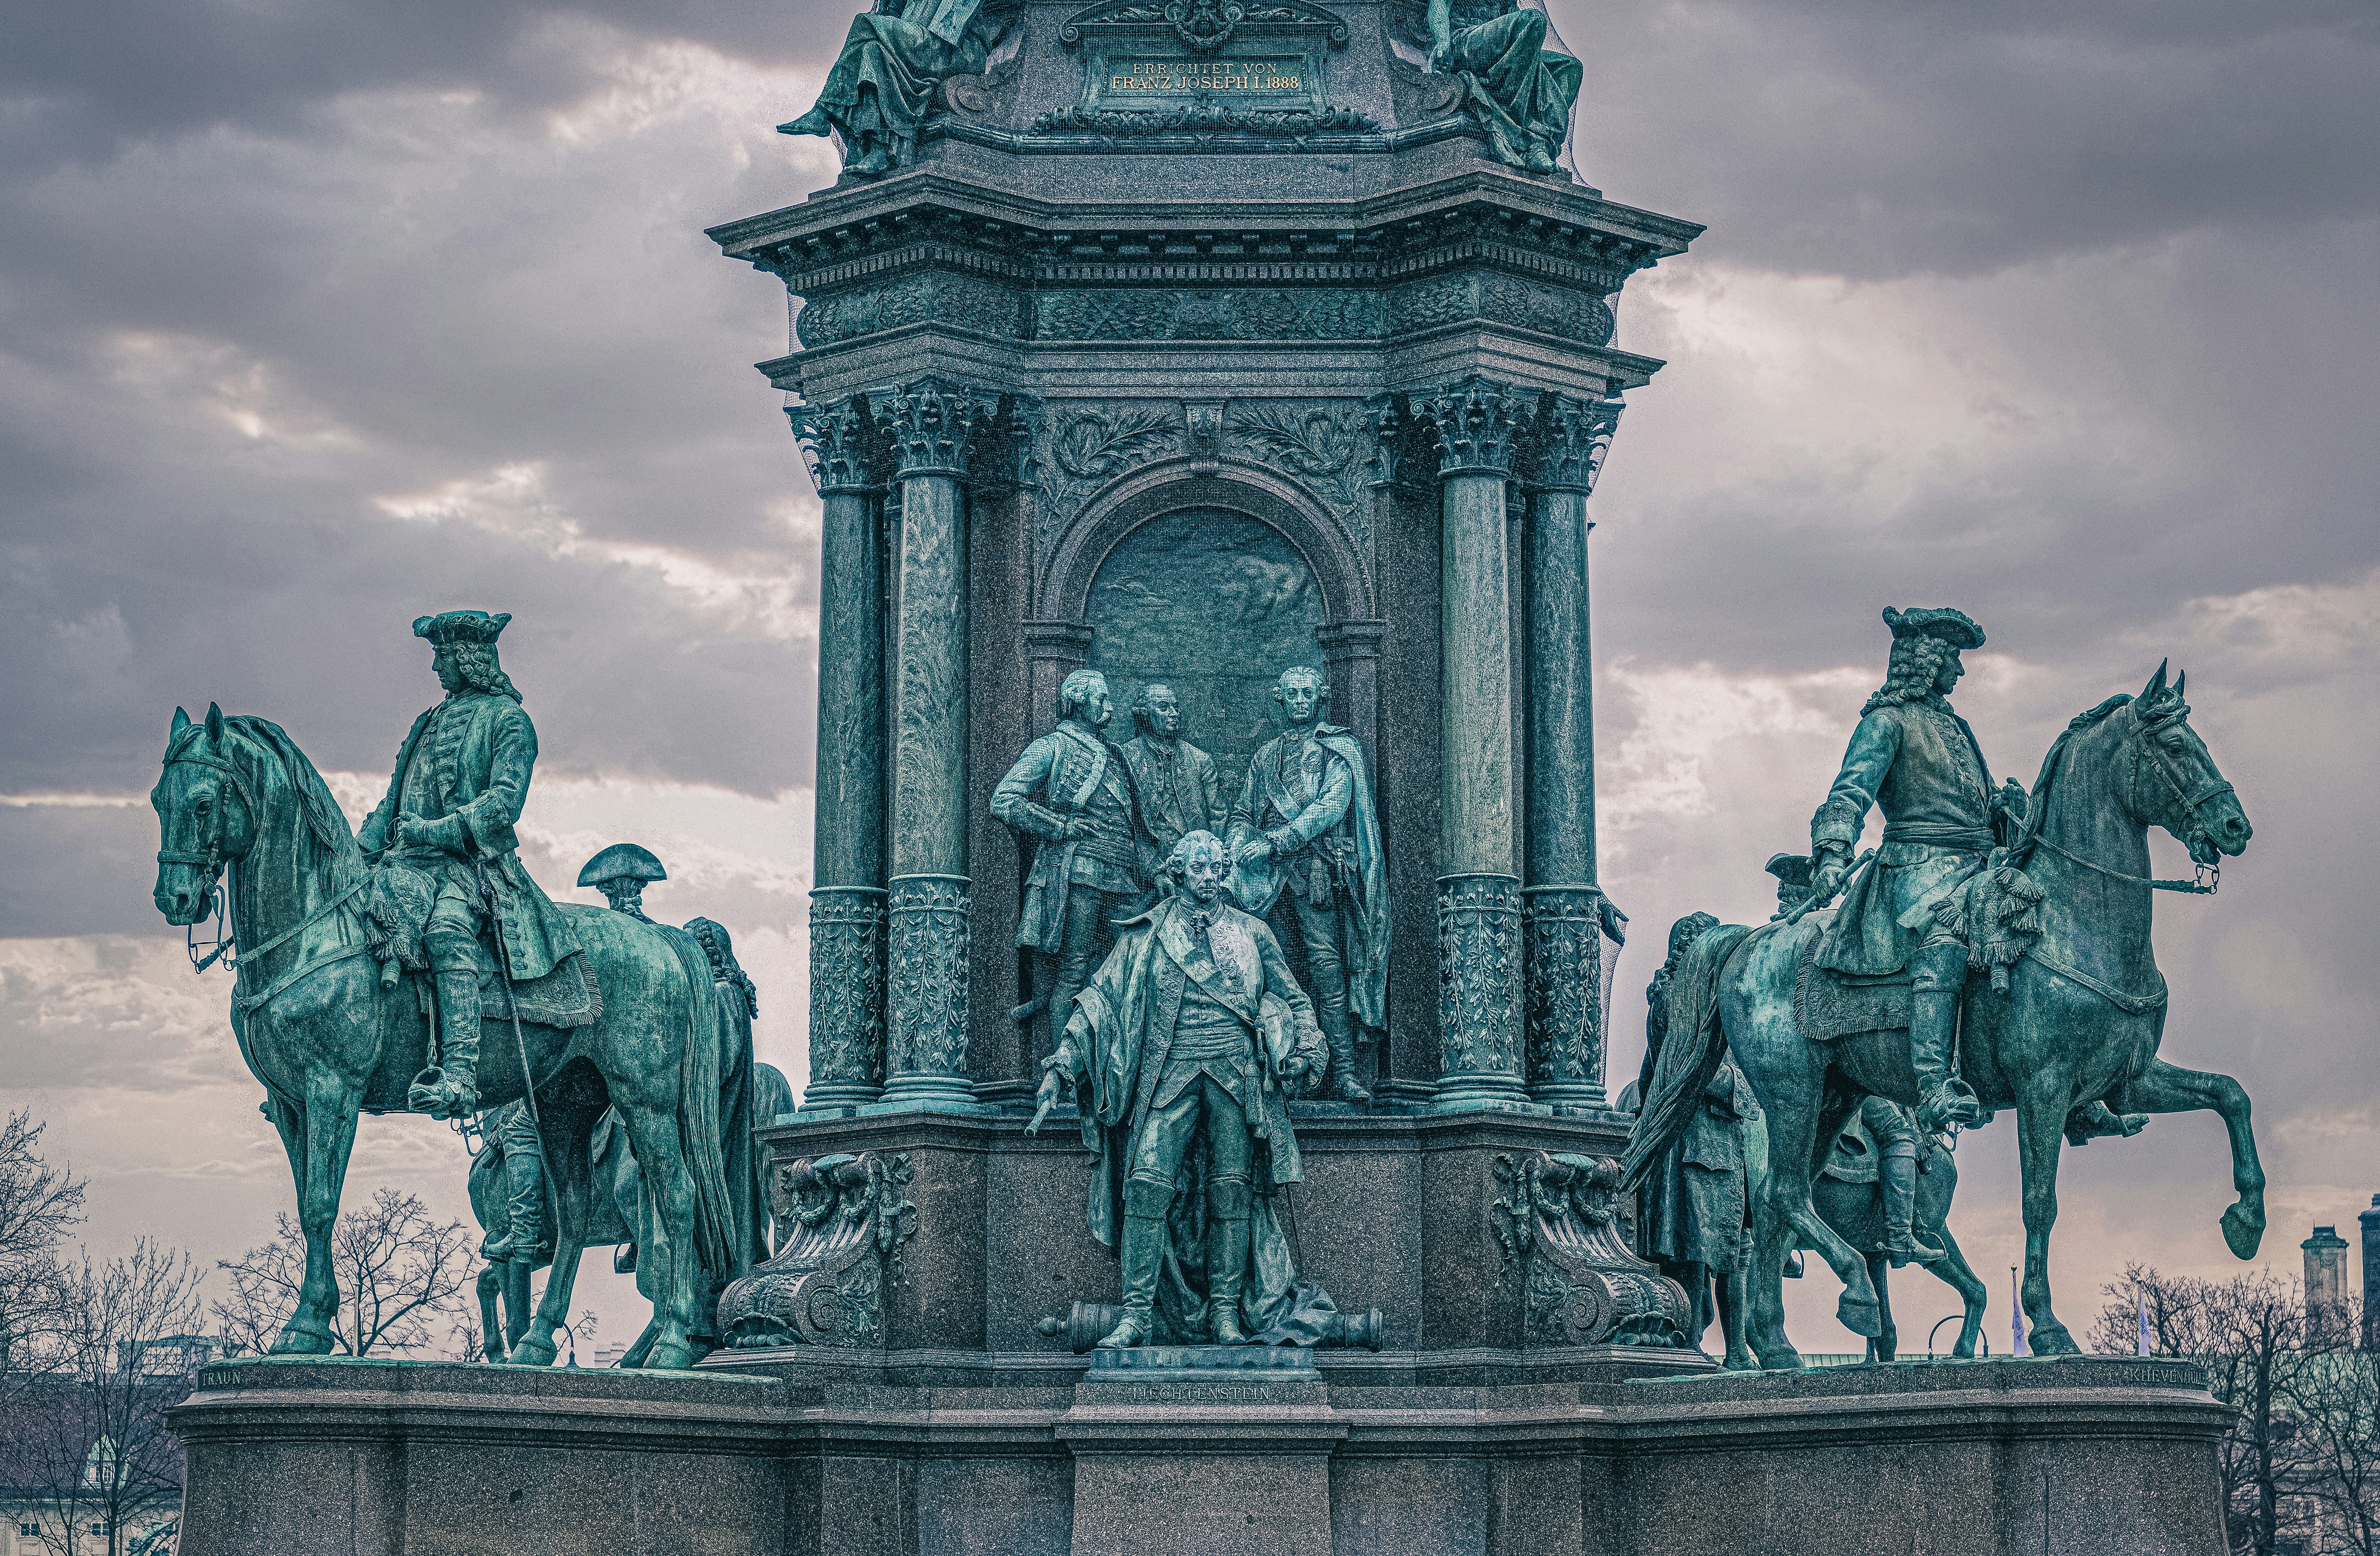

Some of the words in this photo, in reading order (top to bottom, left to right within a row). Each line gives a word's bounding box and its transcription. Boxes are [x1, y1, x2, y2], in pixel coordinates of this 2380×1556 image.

[1133, 63, 1233, 74] ERRICHTET
[1243, 63, 1277, 74] VON
[1112, 76, 1172, 89] FRANZ
[1177, 76, 1249, 89] JOSEPH
[202, 1372, 240, 1385] TRAUN
[1133, 1387, 1269, 1400] LIECHTENSTEIN
